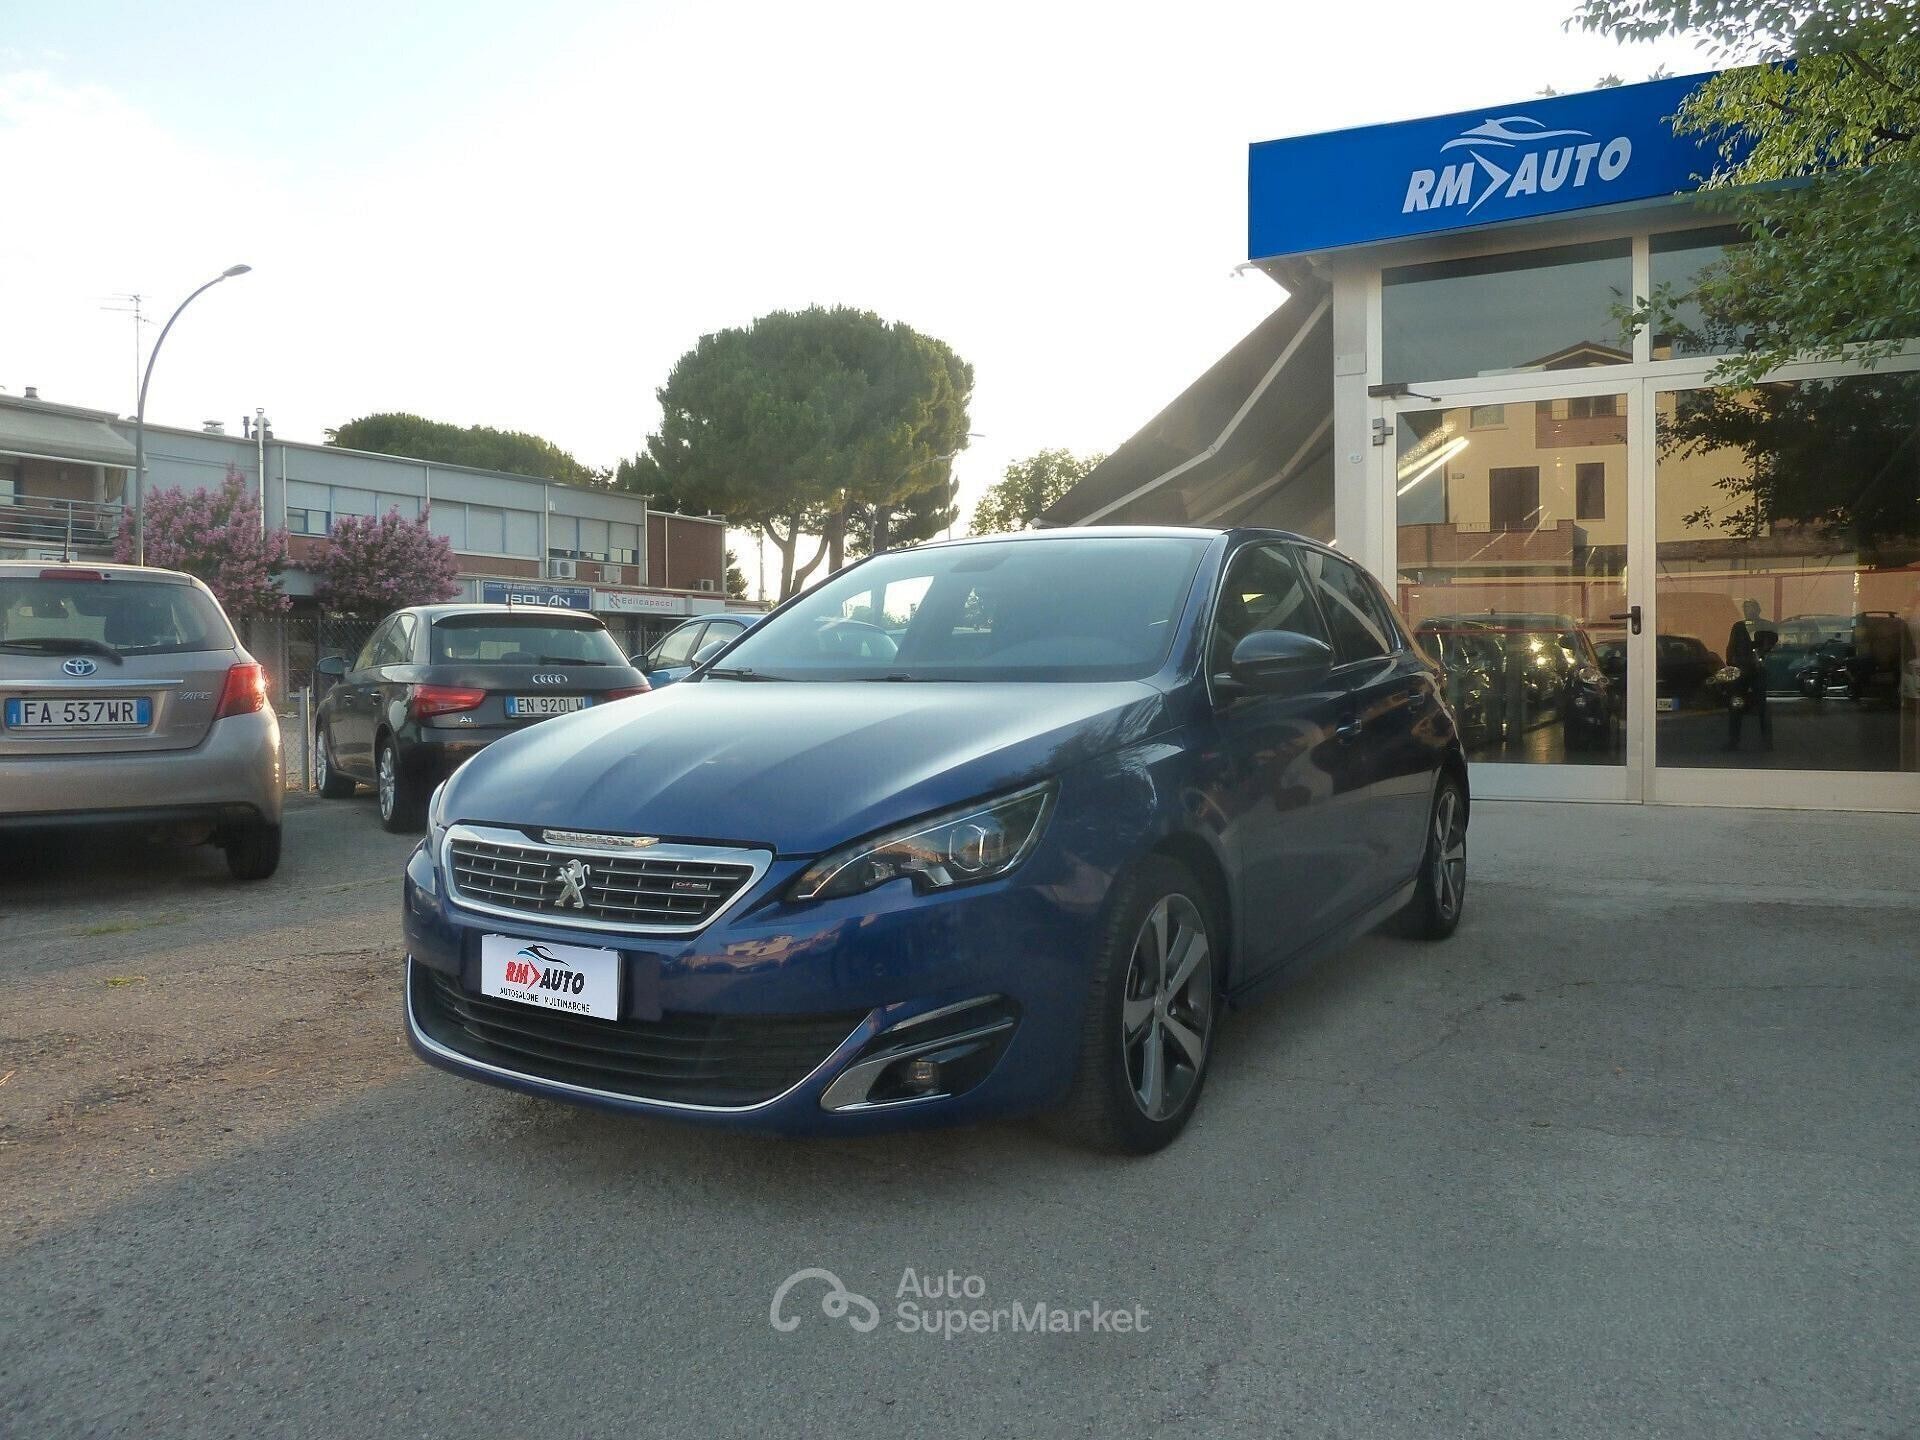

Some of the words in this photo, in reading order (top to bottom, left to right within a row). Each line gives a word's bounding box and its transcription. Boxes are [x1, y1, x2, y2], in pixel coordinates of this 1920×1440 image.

[1401, 161, 1475, 214] RM
[1504, 136, 1632, 199] AUTO
[505, 592, 571, 607] ISOLAN
[621, 596, 673, 608] Edilcapacci
[24, 702, 53, 724] FA
[63, 701, 135, 723] 537WR
[517, 698, 535, 713] EN
[540, 698, 584, 713] 920LW
[504, 961, 530, 985] RM
[538, 967, 585, 995] AUTO
[499, 986, 539, 1003] AUTOSALONE
[543, 996, 591, 1014] MULTIMARCHE
